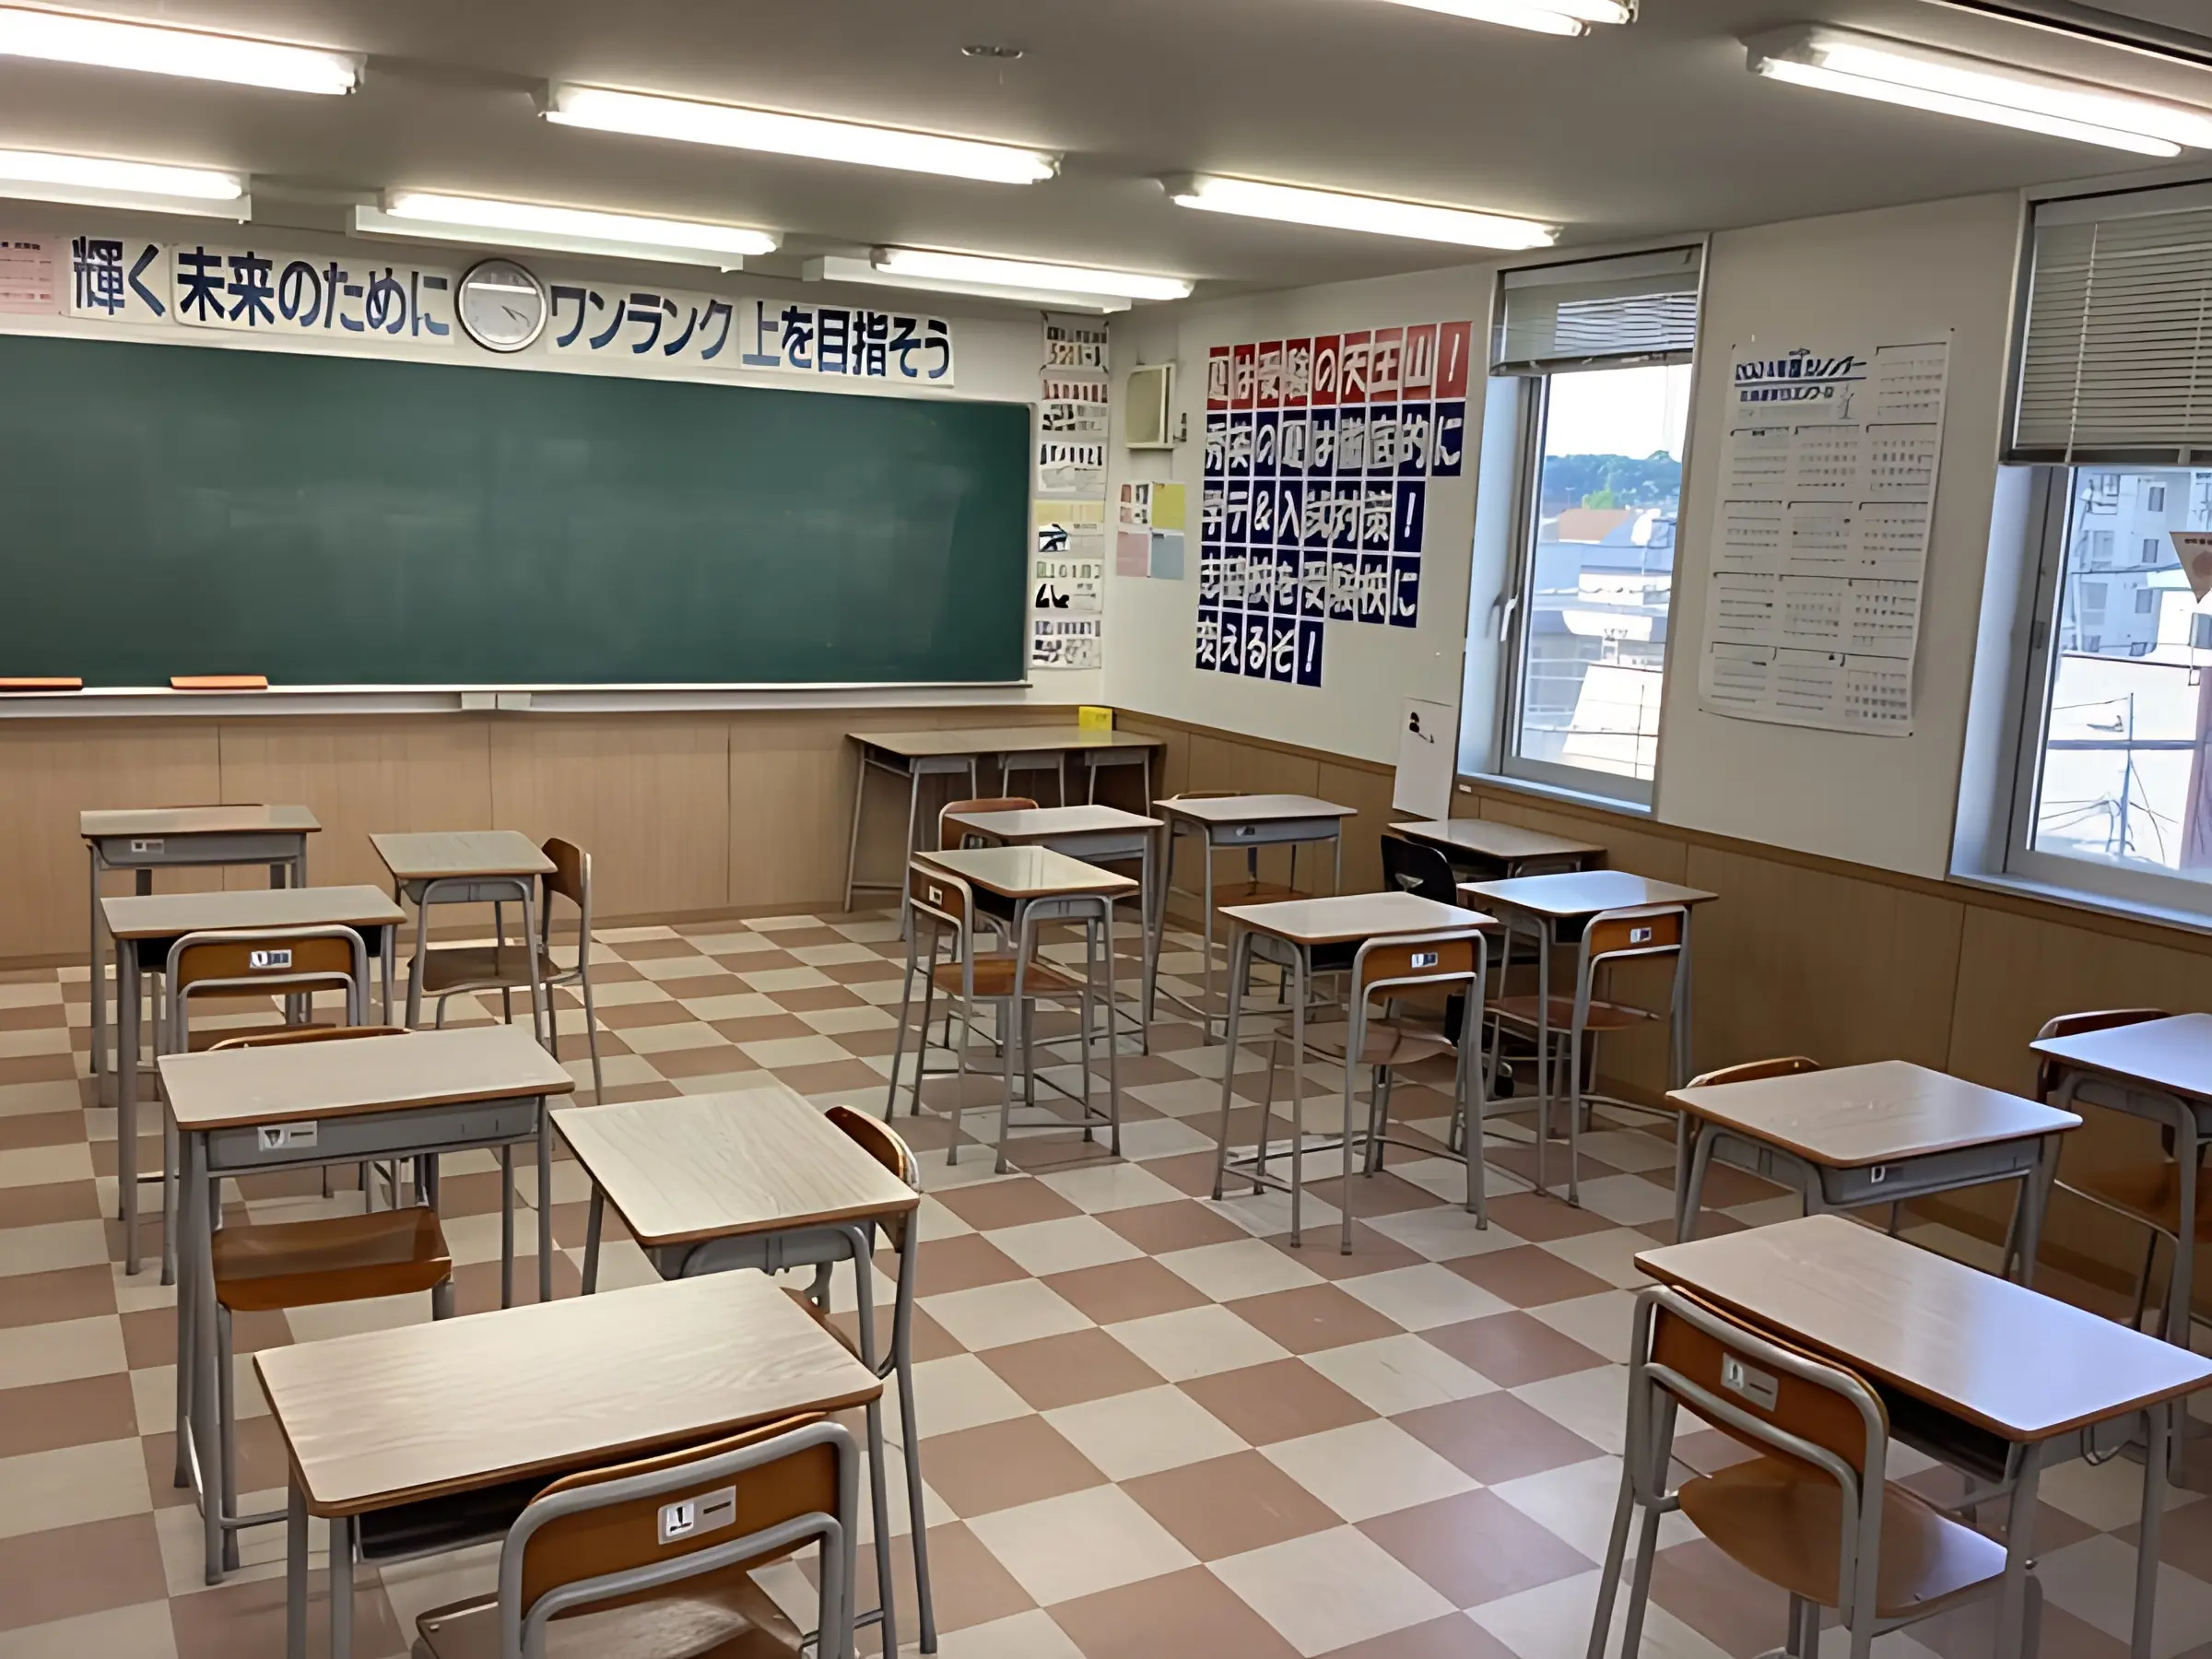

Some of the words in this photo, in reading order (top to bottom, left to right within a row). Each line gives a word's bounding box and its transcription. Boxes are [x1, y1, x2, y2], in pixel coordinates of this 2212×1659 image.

[71, 235, 451, 337] 輝く未来のために
[550, 284, 950, 380] ワンランク上を目指そう
